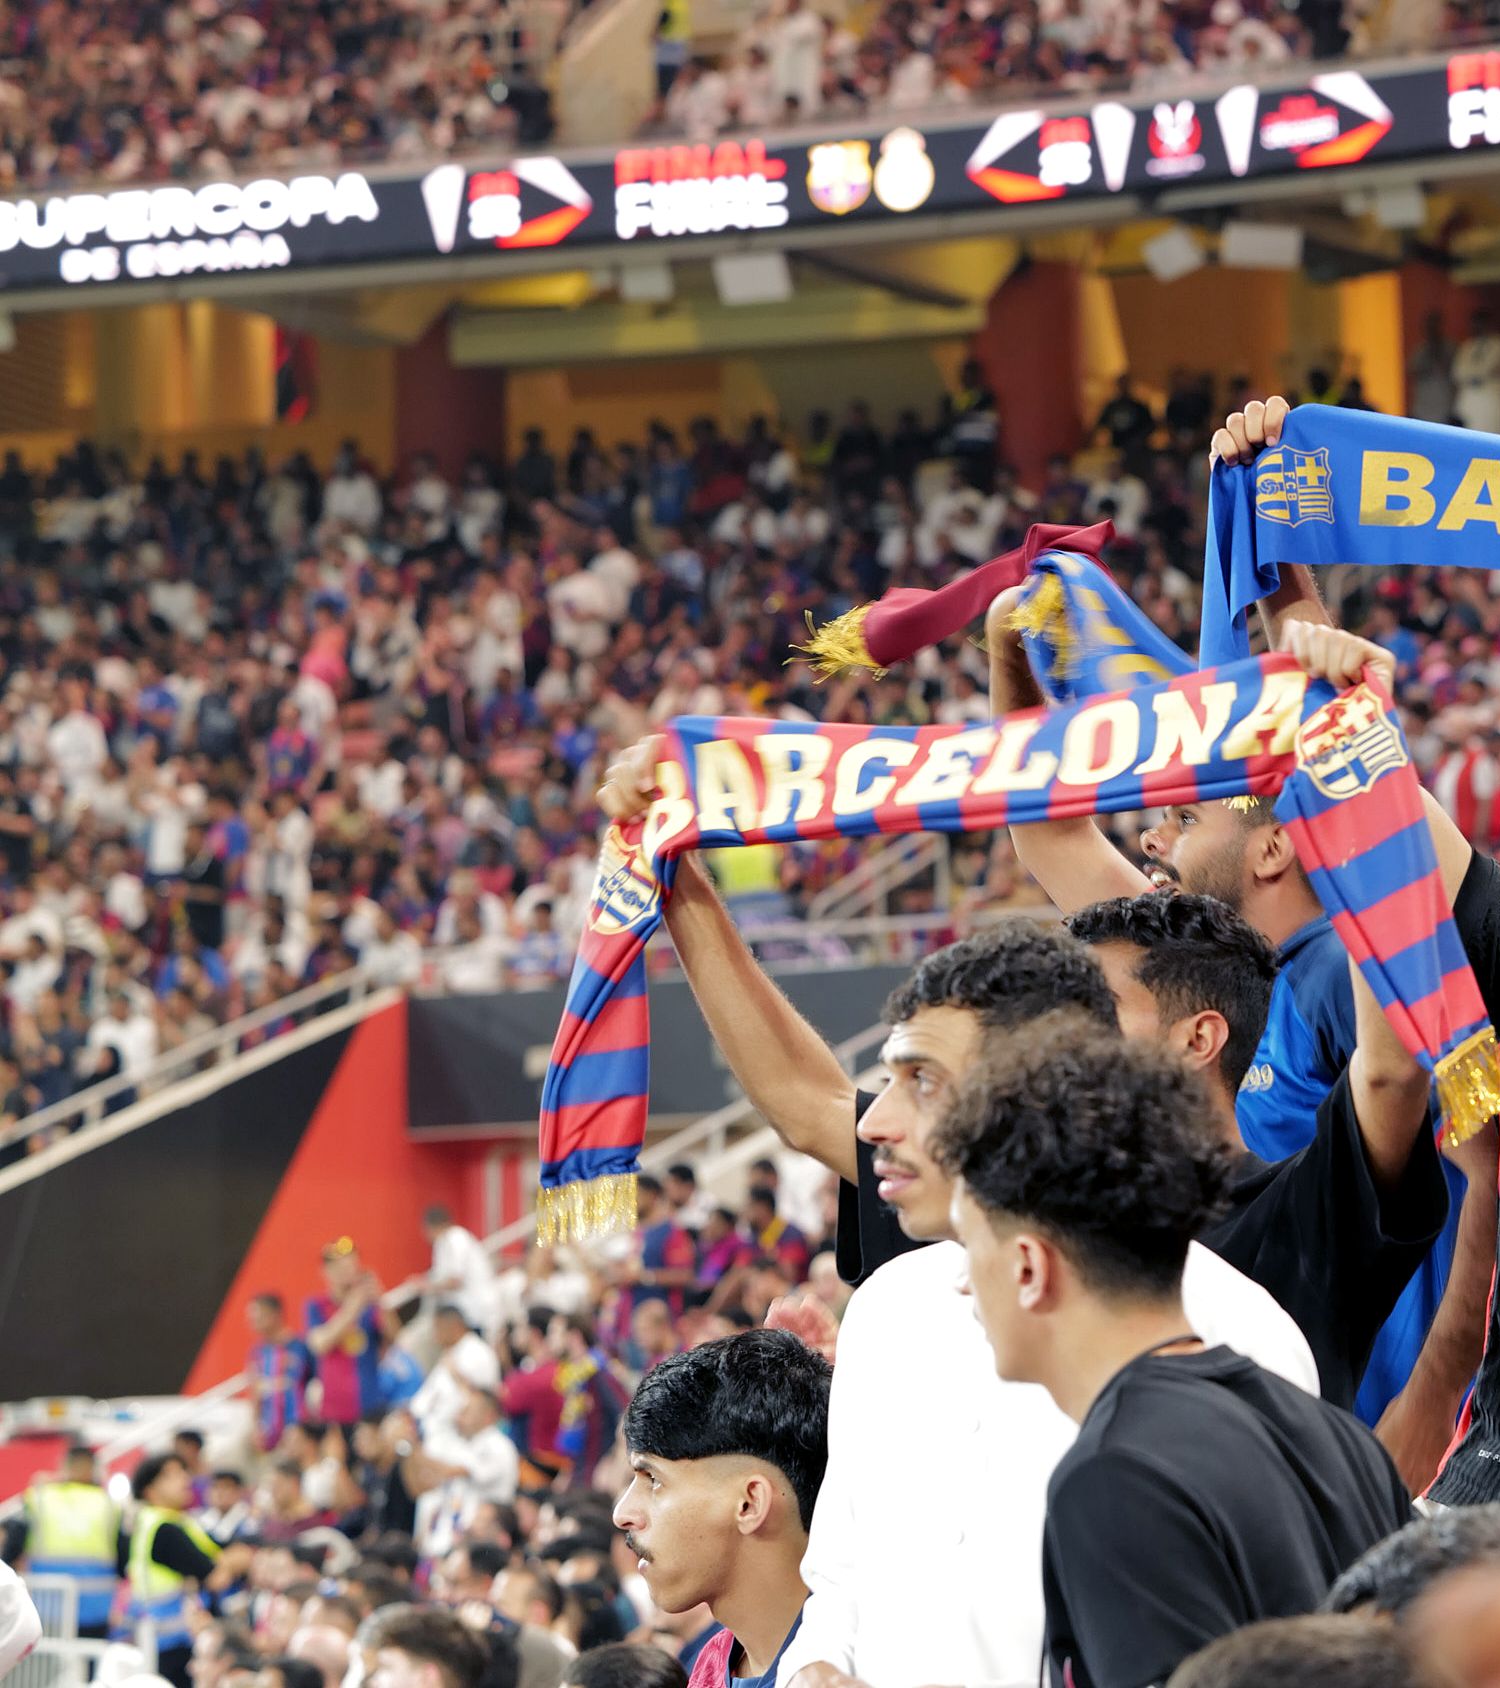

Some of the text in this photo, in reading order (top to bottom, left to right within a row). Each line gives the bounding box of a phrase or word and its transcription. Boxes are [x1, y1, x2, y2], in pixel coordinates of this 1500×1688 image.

[614, 138, 787, 188] FINAL
[60, 248, 120, 283] DE
[1284, 471, 1298, 501] FCB
[642, 671, 1308, 870] BARCELONA
